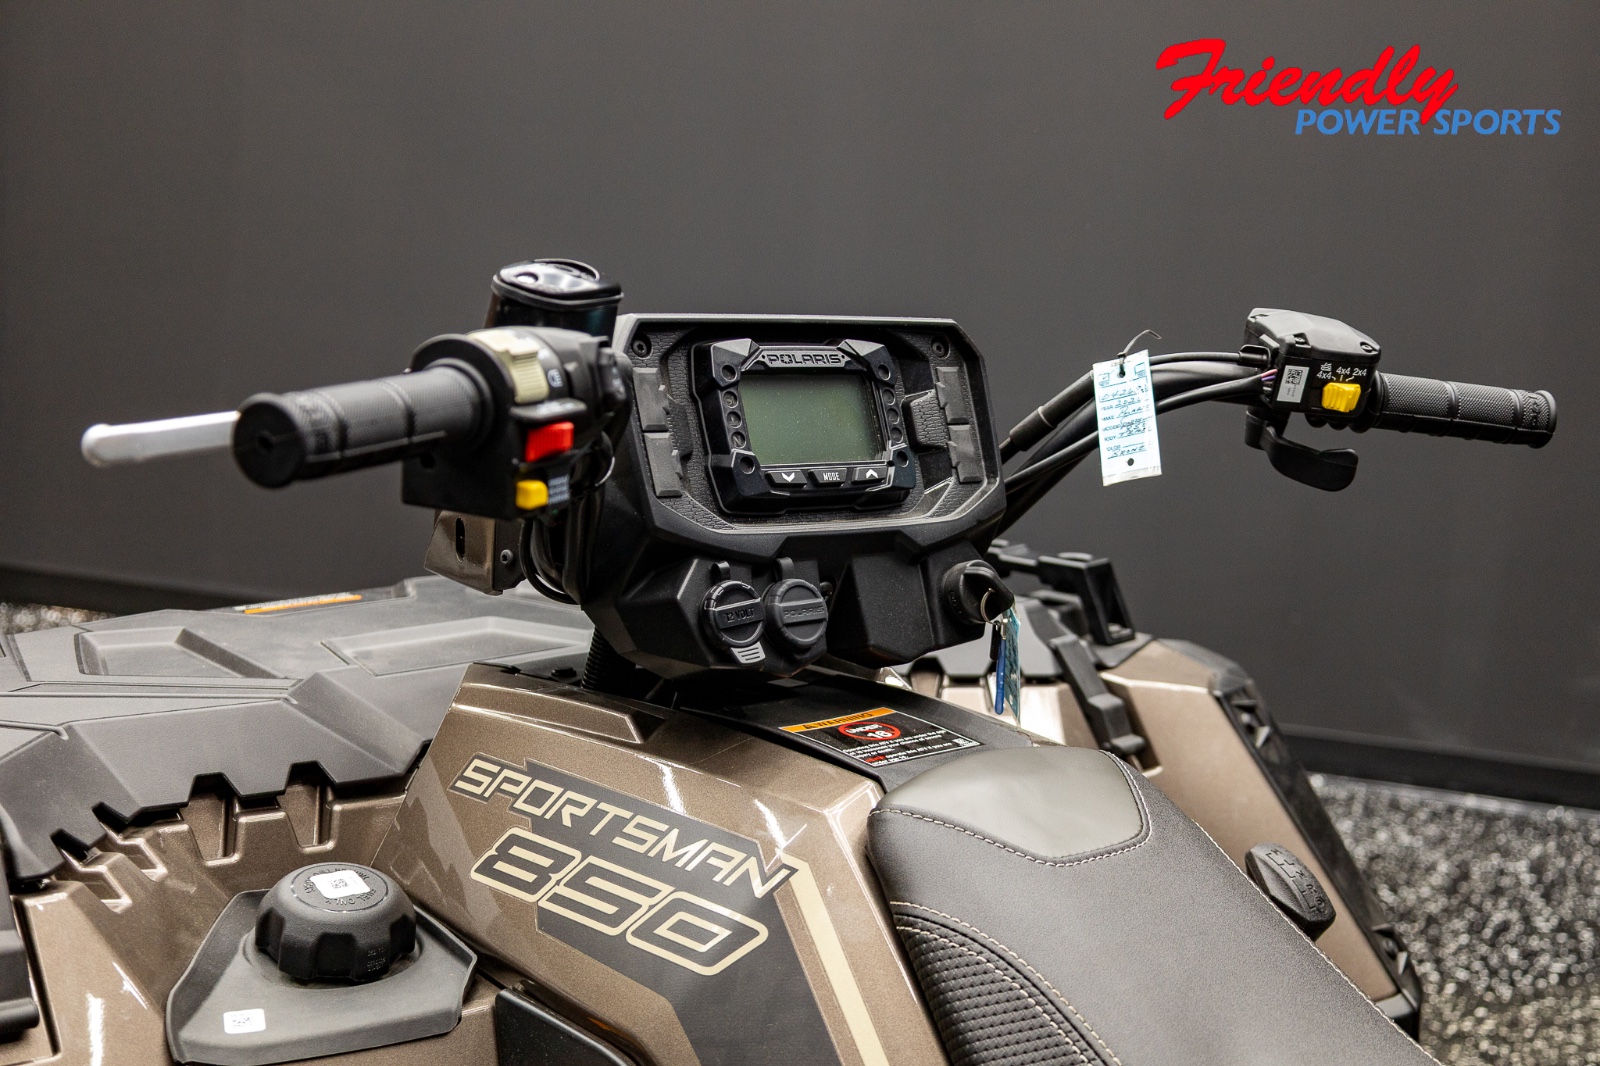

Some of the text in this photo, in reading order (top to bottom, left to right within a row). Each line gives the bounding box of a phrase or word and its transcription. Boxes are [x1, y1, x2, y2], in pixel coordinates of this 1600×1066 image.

[767, 354, 841, 365] POLARIS
[1317, 371, 1332, 380] 4x4
[1336, 366, 1368, 377] 4x4 2x4
[823, 472, 841, 481] MODE
[735, 607, 755, 619] VOLT
[783, 606, 824, 619] POLARIS
[454, 758, 787, 899] SPORTSMAN
[470, 827, 769, 976] 850
